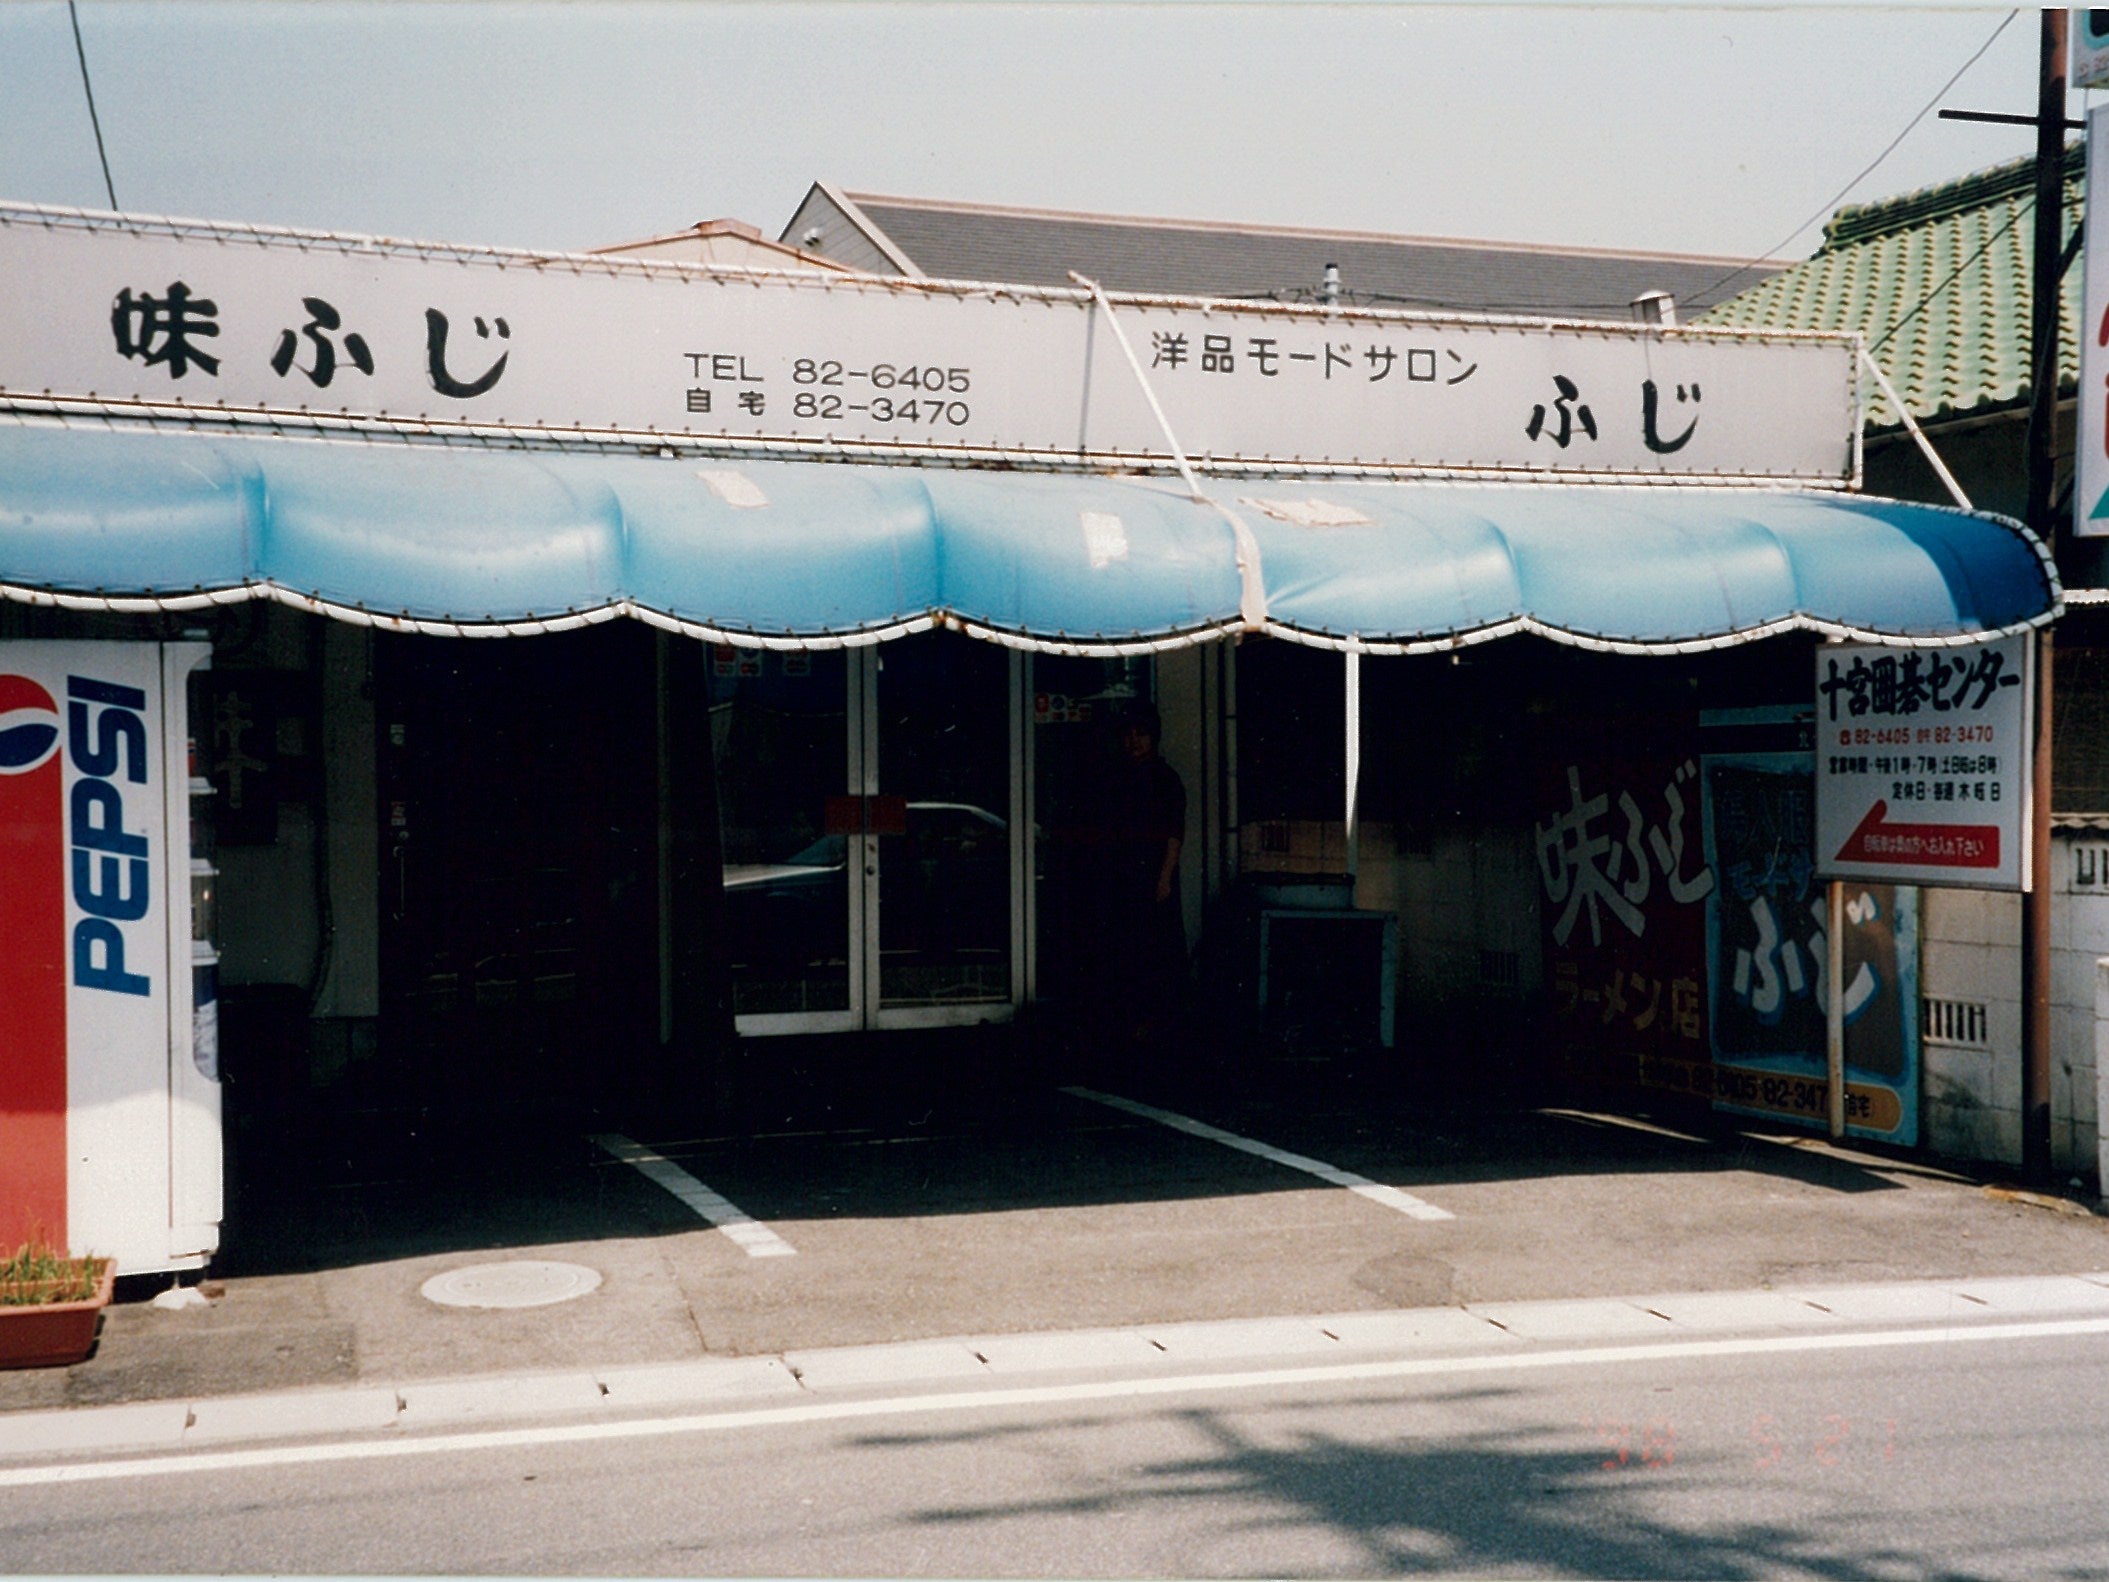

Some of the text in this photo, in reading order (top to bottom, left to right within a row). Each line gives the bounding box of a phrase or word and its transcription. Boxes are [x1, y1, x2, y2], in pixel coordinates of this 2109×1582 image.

[111, 281, 512, 399] 味ふじ
[684, 352, 970, 393] TEL 82-6405
[1151, 331, 1479, 386] 洋品モードサロン
[686, 387, 970, 426] 自宅 82-3470
[1525, 374, 1702, 455] ふじ
[1819, 648, 2021, 721] 十宮囲碁センター
[1855, 727, 1910, 745] 82-6405
[1934, 725, 1994, 744] 82-3470
[67, 674, 151, 997] PEPSI
[1536, 757, 1716, 947] 味ふじ
[1732, 891, 1879, 1016] ふじ
